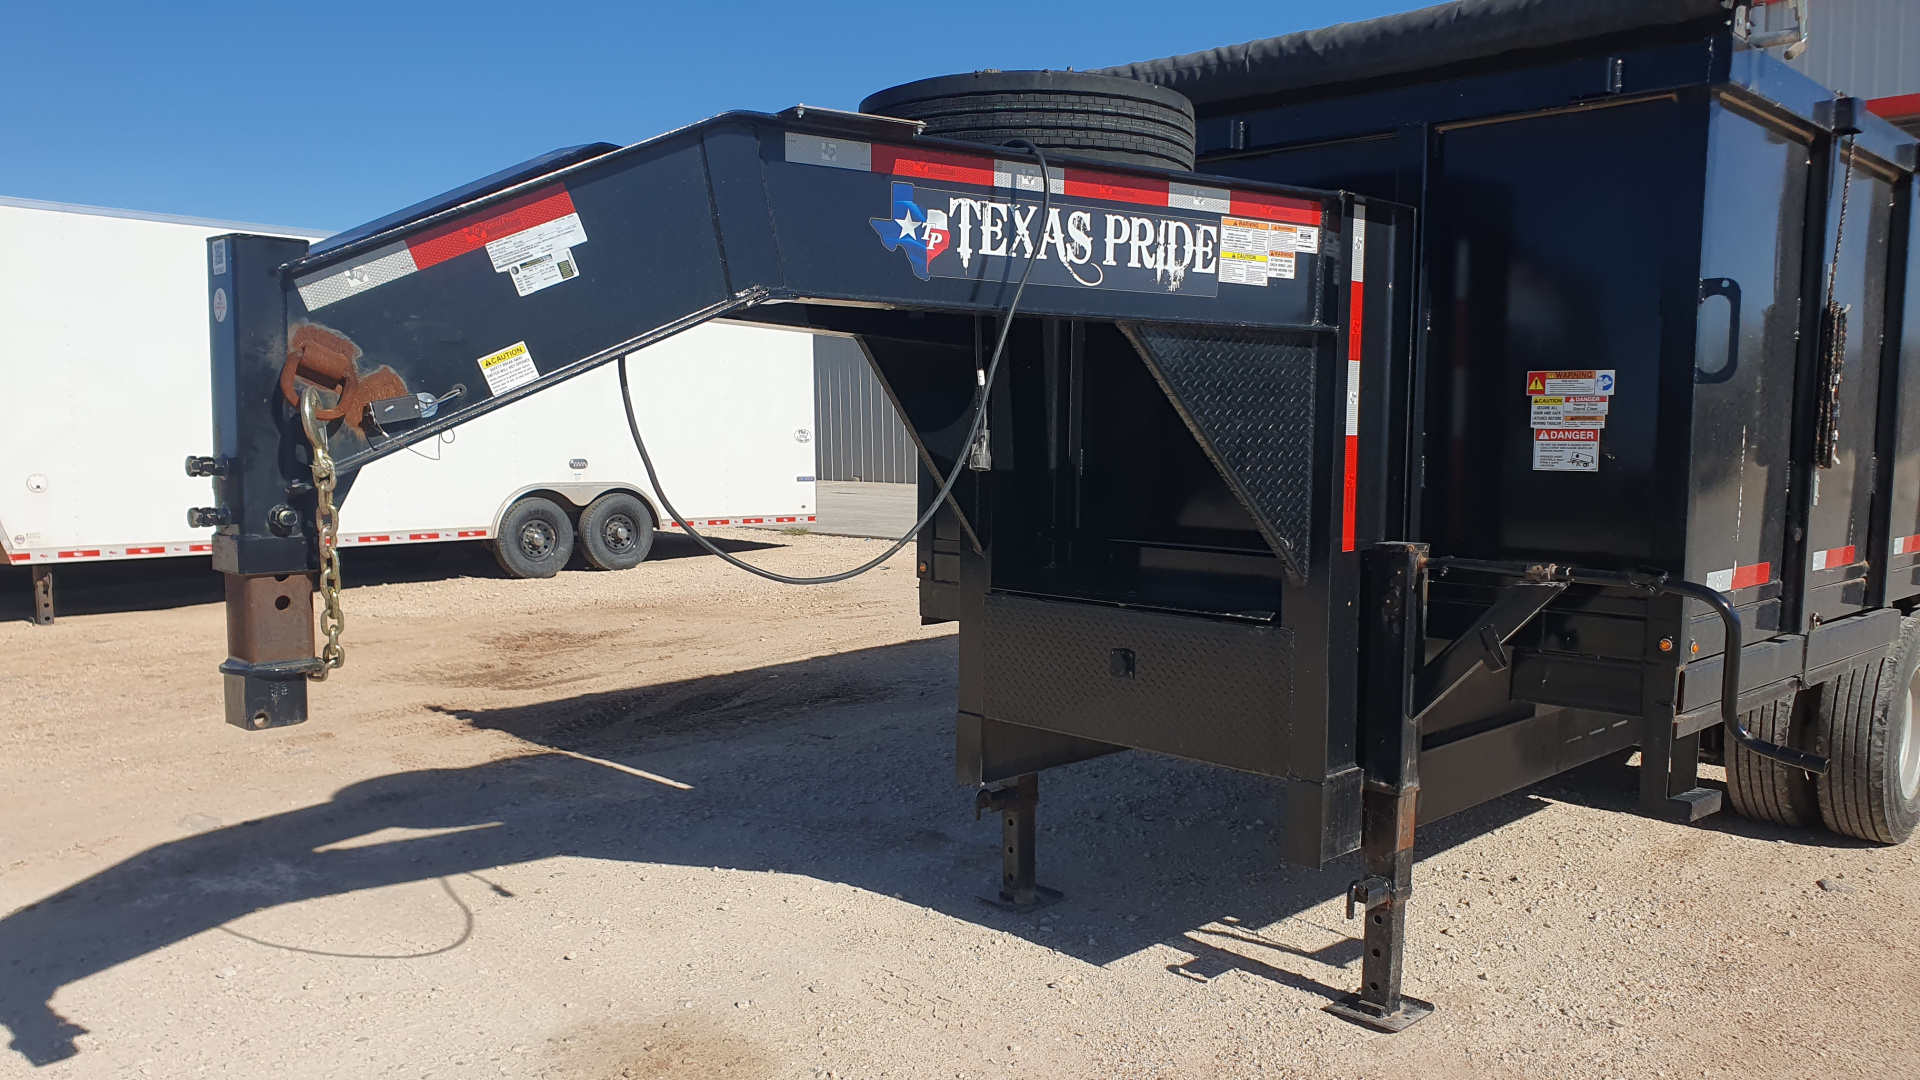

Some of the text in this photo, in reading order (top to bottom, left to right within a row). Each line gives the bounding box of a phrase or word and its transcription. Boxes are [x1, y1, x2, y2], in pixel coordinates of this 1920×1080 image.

[1238, 220, 1259, 228] WARNING
[920, 221, 943, 251] TP
[949, 198, 1217, 292] TEXAS PRIDE
[490, 347, 522, 364] CAUTION
[1550, 431, 1594, 440] DANGER
